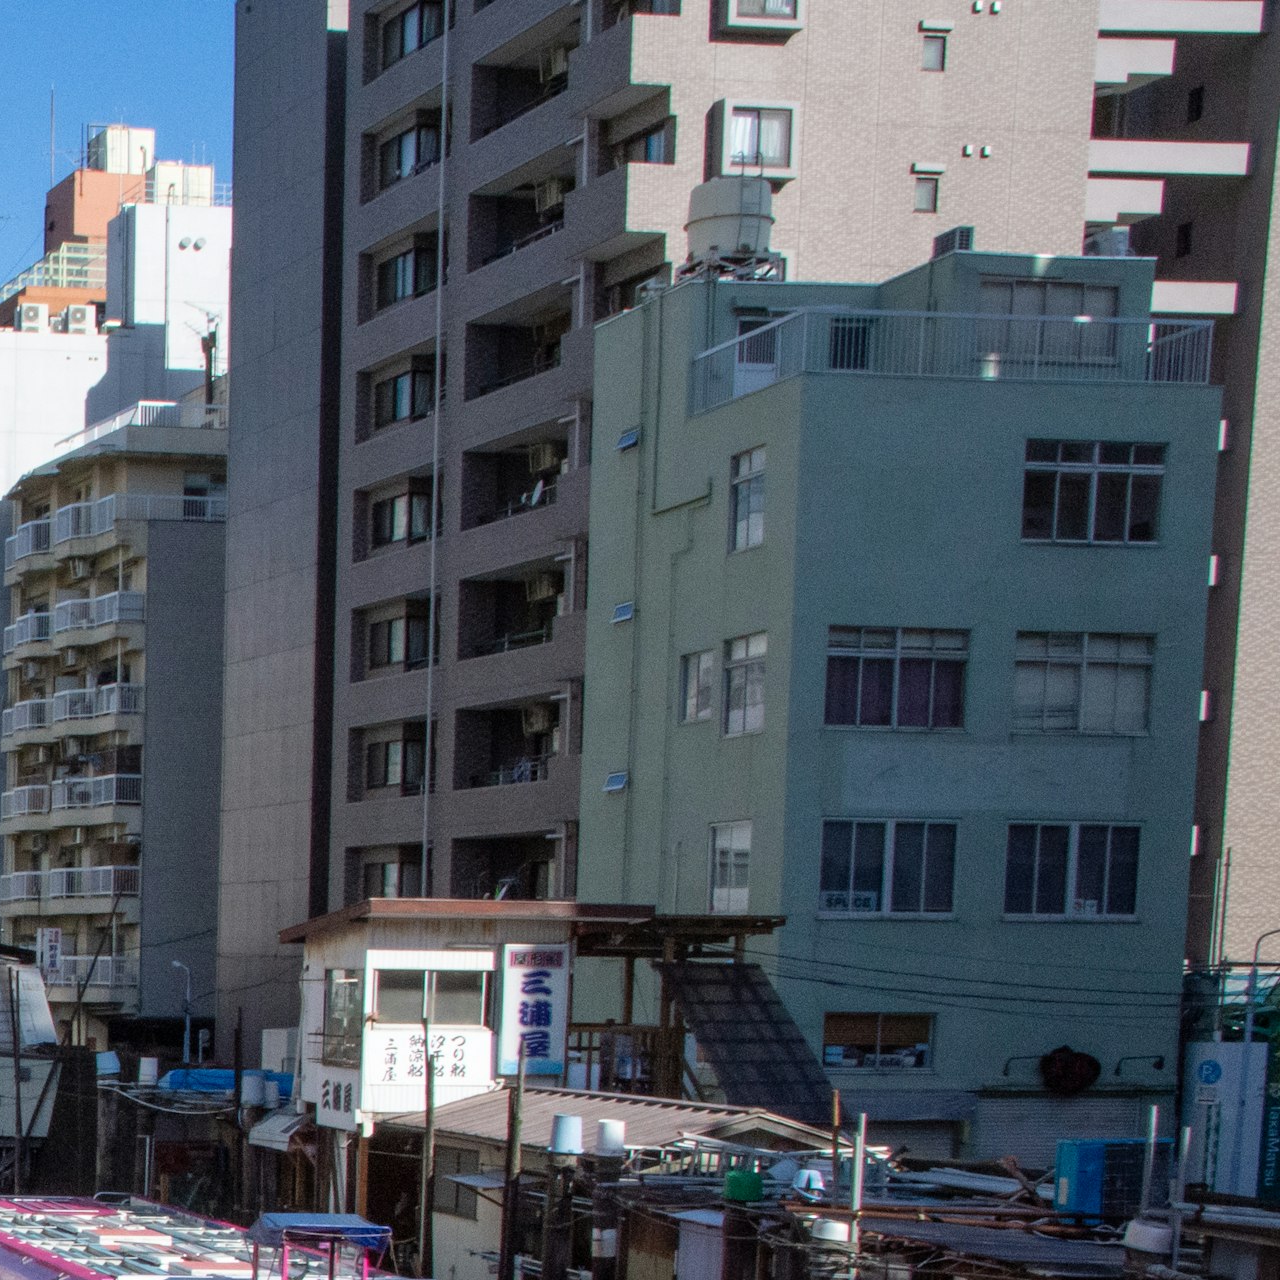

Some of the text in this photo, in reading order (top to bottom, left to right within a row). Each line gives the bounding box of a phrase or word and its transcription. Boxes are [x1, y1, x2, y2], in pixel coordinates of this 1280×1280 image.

[519, 970, 552, 1058] 三浦屋
[382, 1038, 398, 1082] 三浦屋
[451, 1035, 466, 1078] つり船
